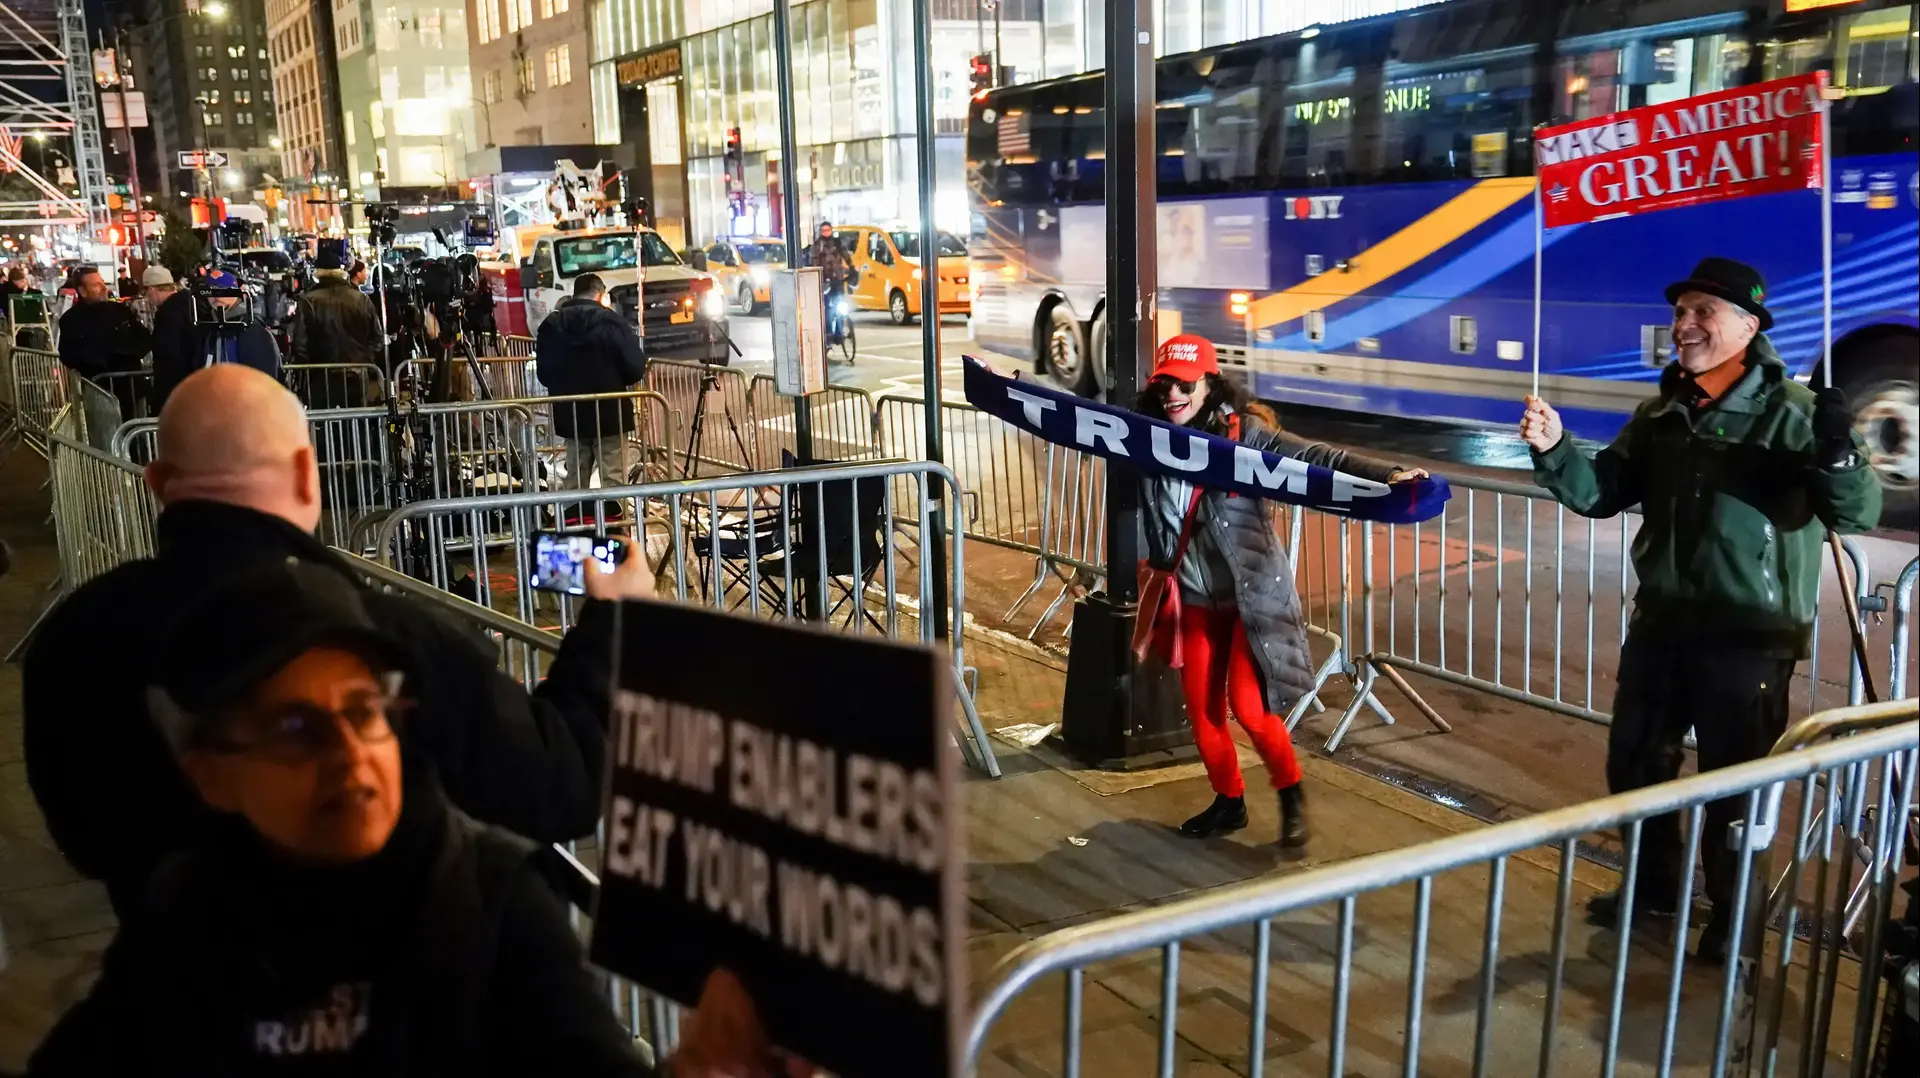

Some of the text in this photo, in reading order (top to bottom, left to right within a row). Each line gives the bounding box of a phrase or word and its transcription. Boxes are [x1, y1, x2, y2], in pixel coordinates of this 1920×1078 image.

[1536, 120, 1636, 166] MAKE
[1649, 84, 1825, 143] AMERICA
[831, 165, 880, 187] GUCCI
[1578, 130, 1791, 207] GREAT!
[1168, 343, 1198, 354] TRUMP
[1168, 352, 1198, 362] TRUST
[1007, 386, 1391, 501] TRUMP
[612, 690, 942, 872] TRUMP ENABLERS
[606, 796, 944, 1006] EAT YOUR WORDS
